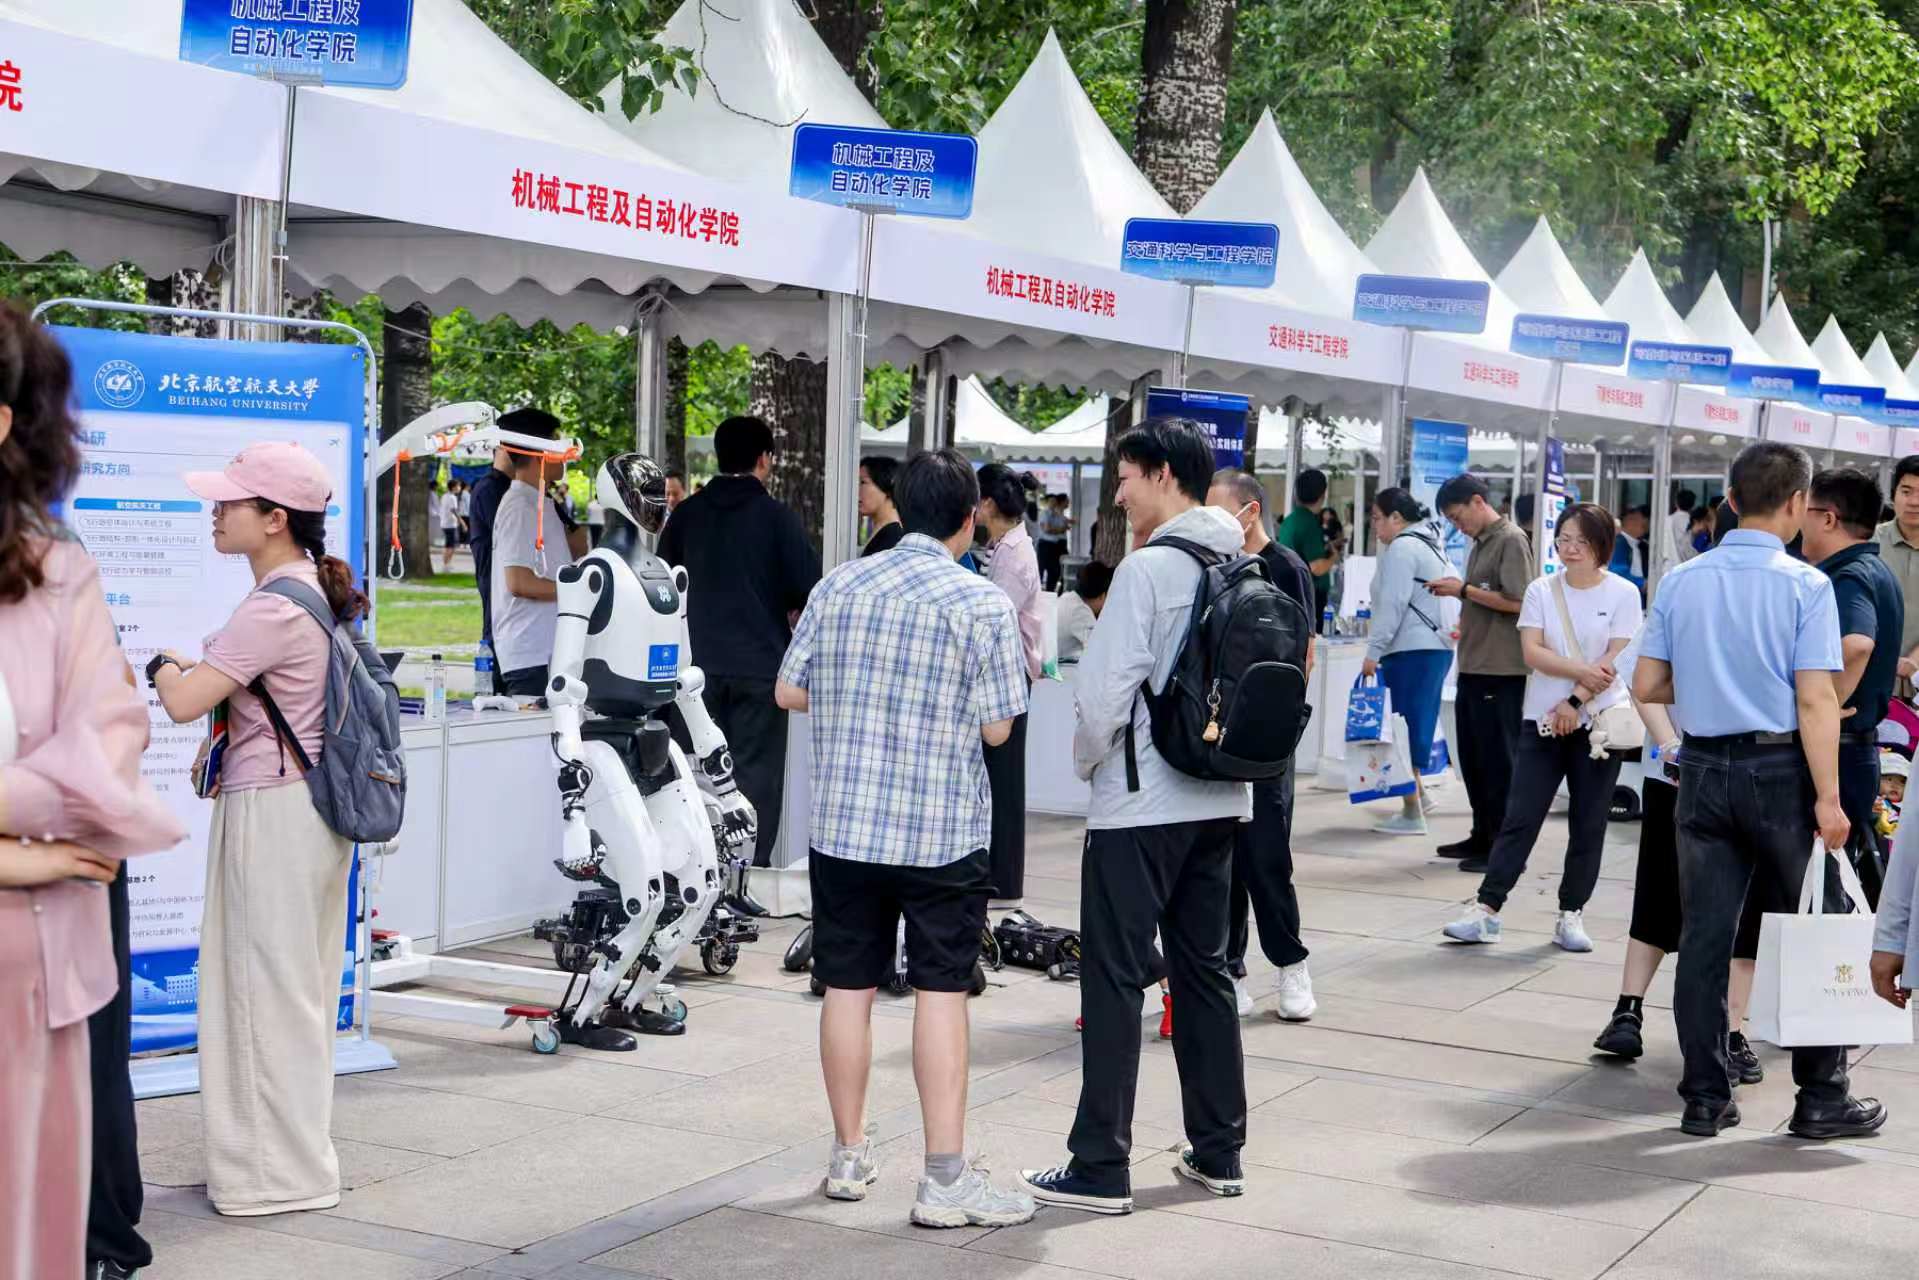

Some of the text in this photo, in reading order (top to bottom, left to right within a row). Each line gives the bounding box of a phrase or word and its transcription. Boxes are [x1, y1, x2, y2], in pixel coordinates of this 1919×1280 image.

[229, 25, 357, 64] 自动化学院
[832, 143, 935, 172] 机械工程及
[831, 170, 932, 200] 自动化学院
[511, 168, 741, 247] 机械工程及自动化学院
[1126, 239, 1275, 266] 交通科学与工程学院
[986, 264, 1117, 319] 机械工程及自动化学院
[1268, 324, 1350, 360] 交通科学与工程学院
[168, 395, 309, 413] BEIHANG UNIVERSITY
[106, 592, 132, 606] 平台
